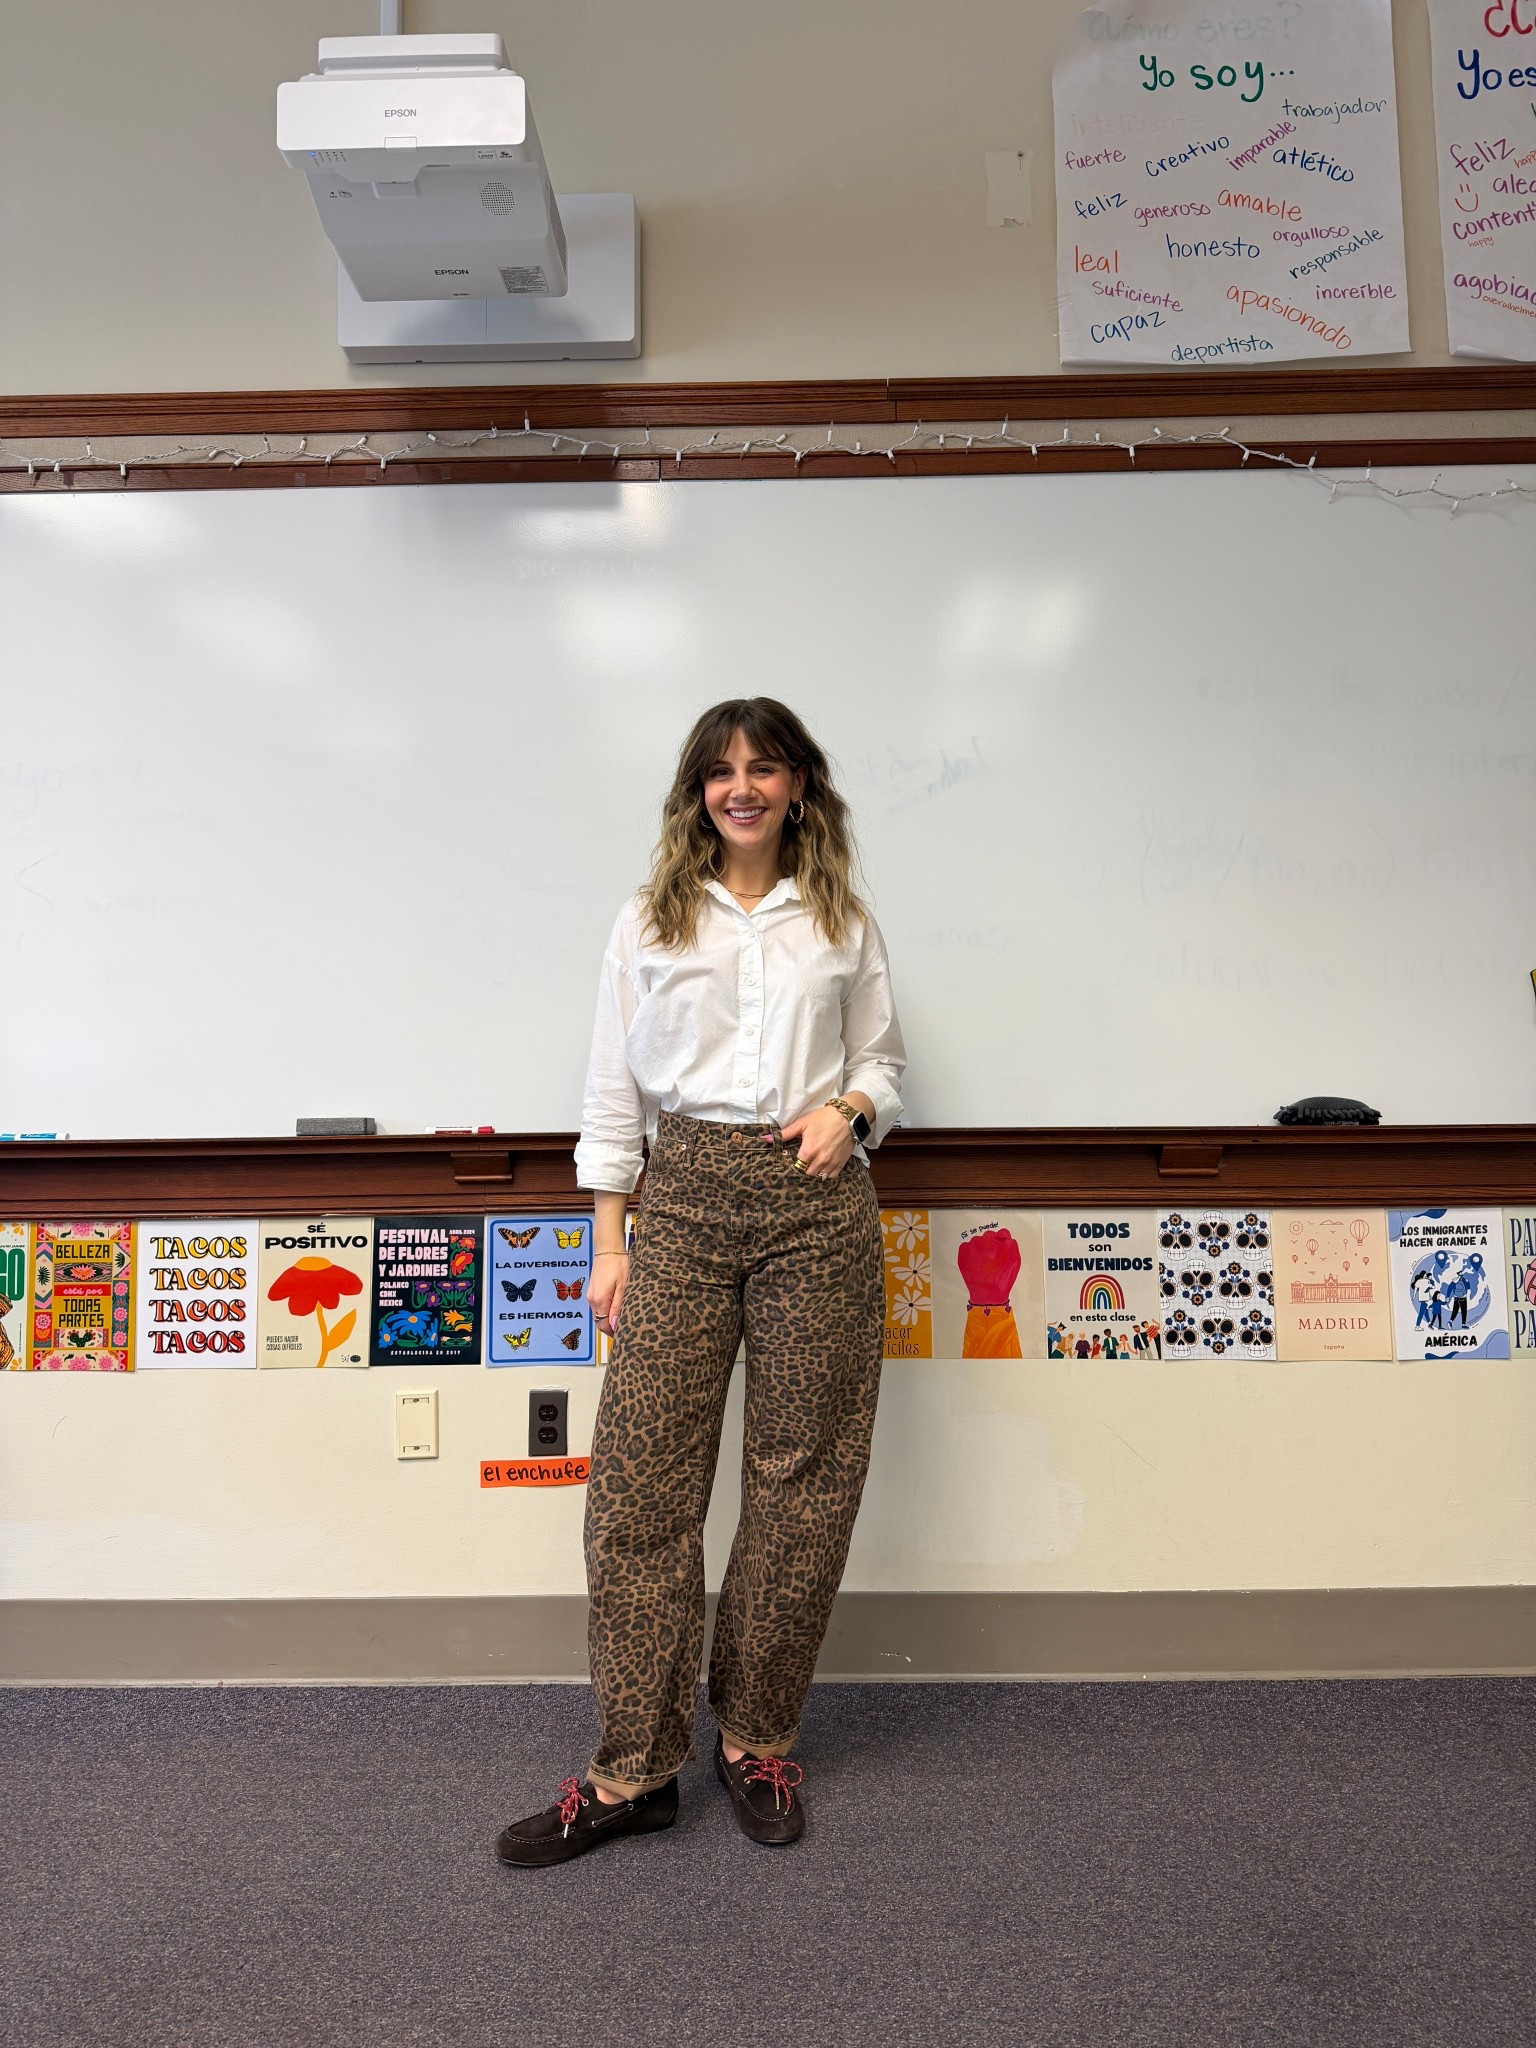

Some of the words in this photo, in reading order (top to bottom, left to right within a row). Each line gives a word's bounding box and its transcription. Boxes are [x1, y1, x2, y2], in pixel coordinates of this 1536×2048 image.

[1139, 54, 1175, 91] Yo
[1457, 49, 1502, 99] Yo
[384, 108, 417, 118] EPSON
[1282, 98, 1387, 124] trabajador
[1226, 121, 1297, 171] imparable
[1065, 149, 1127, 170] fuerte
[1145, 136, 1230, 177] creativo
[1273, 147, 1354, 182] atlético
[1450, 138, 1516, 176] feliz
[1075, 192, 1128, 219] feliz
[1217, 189, 1302, 222] amable
[1134, 202, 1211, 228] generoso
[1453, 200, 1536, 240] content
[1273, 225, 1349, 247] orgulloso
[1467, 236, 1494, 248] happy
[1166, 233, 1260, 258] honesto
[1289, 228, 1384, 279] responsable
[1075, 244, 1118, 274] leal
[1092, 280, 1183, 312] suficiente
[1316, 283, 1397, 300] increíble
[1226, 285, 1352, 350] apasionado
[1090, 311, 1166, 343] capaz
[1171, 334, 1273, 363] deportista
[307, 1223, 326, 1233] SÉ
[379, 1228, 449, 1244] FESTIVAL
[1067, 1223, 1130, 1239] TODOS
[1402, 1226, 1419, 1236] LOS
[1422, 1225, 1488, 1236] INMIGRANTES
[264, 1234, 368, 1250] POSITIVO
[1400, 1237, 1433, 1248] HACEN
[1436, 1236, 1476, 1247] GRANDE
[1480, 1236, 1488, 1246] A
[1509, 1218, 1536, 1256] PA
[56, 1244, 110, 1259] BELLEZA
[150, 1236, 248, 1260] TACOS
[379, 1246, 396, 1260] DE
[398, 1246, 448, 1260] FLORES
[1088, 1243, 1112, 1252] son
[379, 1264, 386, 1277] Y
[388, 1264, 448, 1277] JARDINES
[513, 1260, 588, 1269] DIVERSIDAD
[1048, 1257, 1153, 1271] BIENVENIDOS
[149, 1268, 248, 1291] TACOS
[379, 1281, 409, 1289] POLANCO
[63, 1286, 84, 1295] está
[85, 1287, 103, 1296] por
[379, 1290, 397, 1298] CDMX
[63, 1298, 101, 1312] TODAS
[148, 1299, 247, 1323] TACOS
[59, 1313, 104, 1327] PARTES
[499, 1313, 514, 1321] ES
[516, 1311, 583, 1320] HERMOSA
[1085, 1313, 1107, 1321] esta
[1110, 1312, 1136, 1321] clase
[1298, 1318, 1369, 1330] MADRID
[147, 1330, 246, 1354] TACOS
[266, 1335, 283, 1343] PUEDES
[885, 1327, 913, 1340] acer
[1424, 1333, 1478, 1347] AMÉRICA
[266, 1343, 281, 1351] COSAS
[483, 1466, 501, 1481] el
[506, 1461, 590, 1481] enchufe
